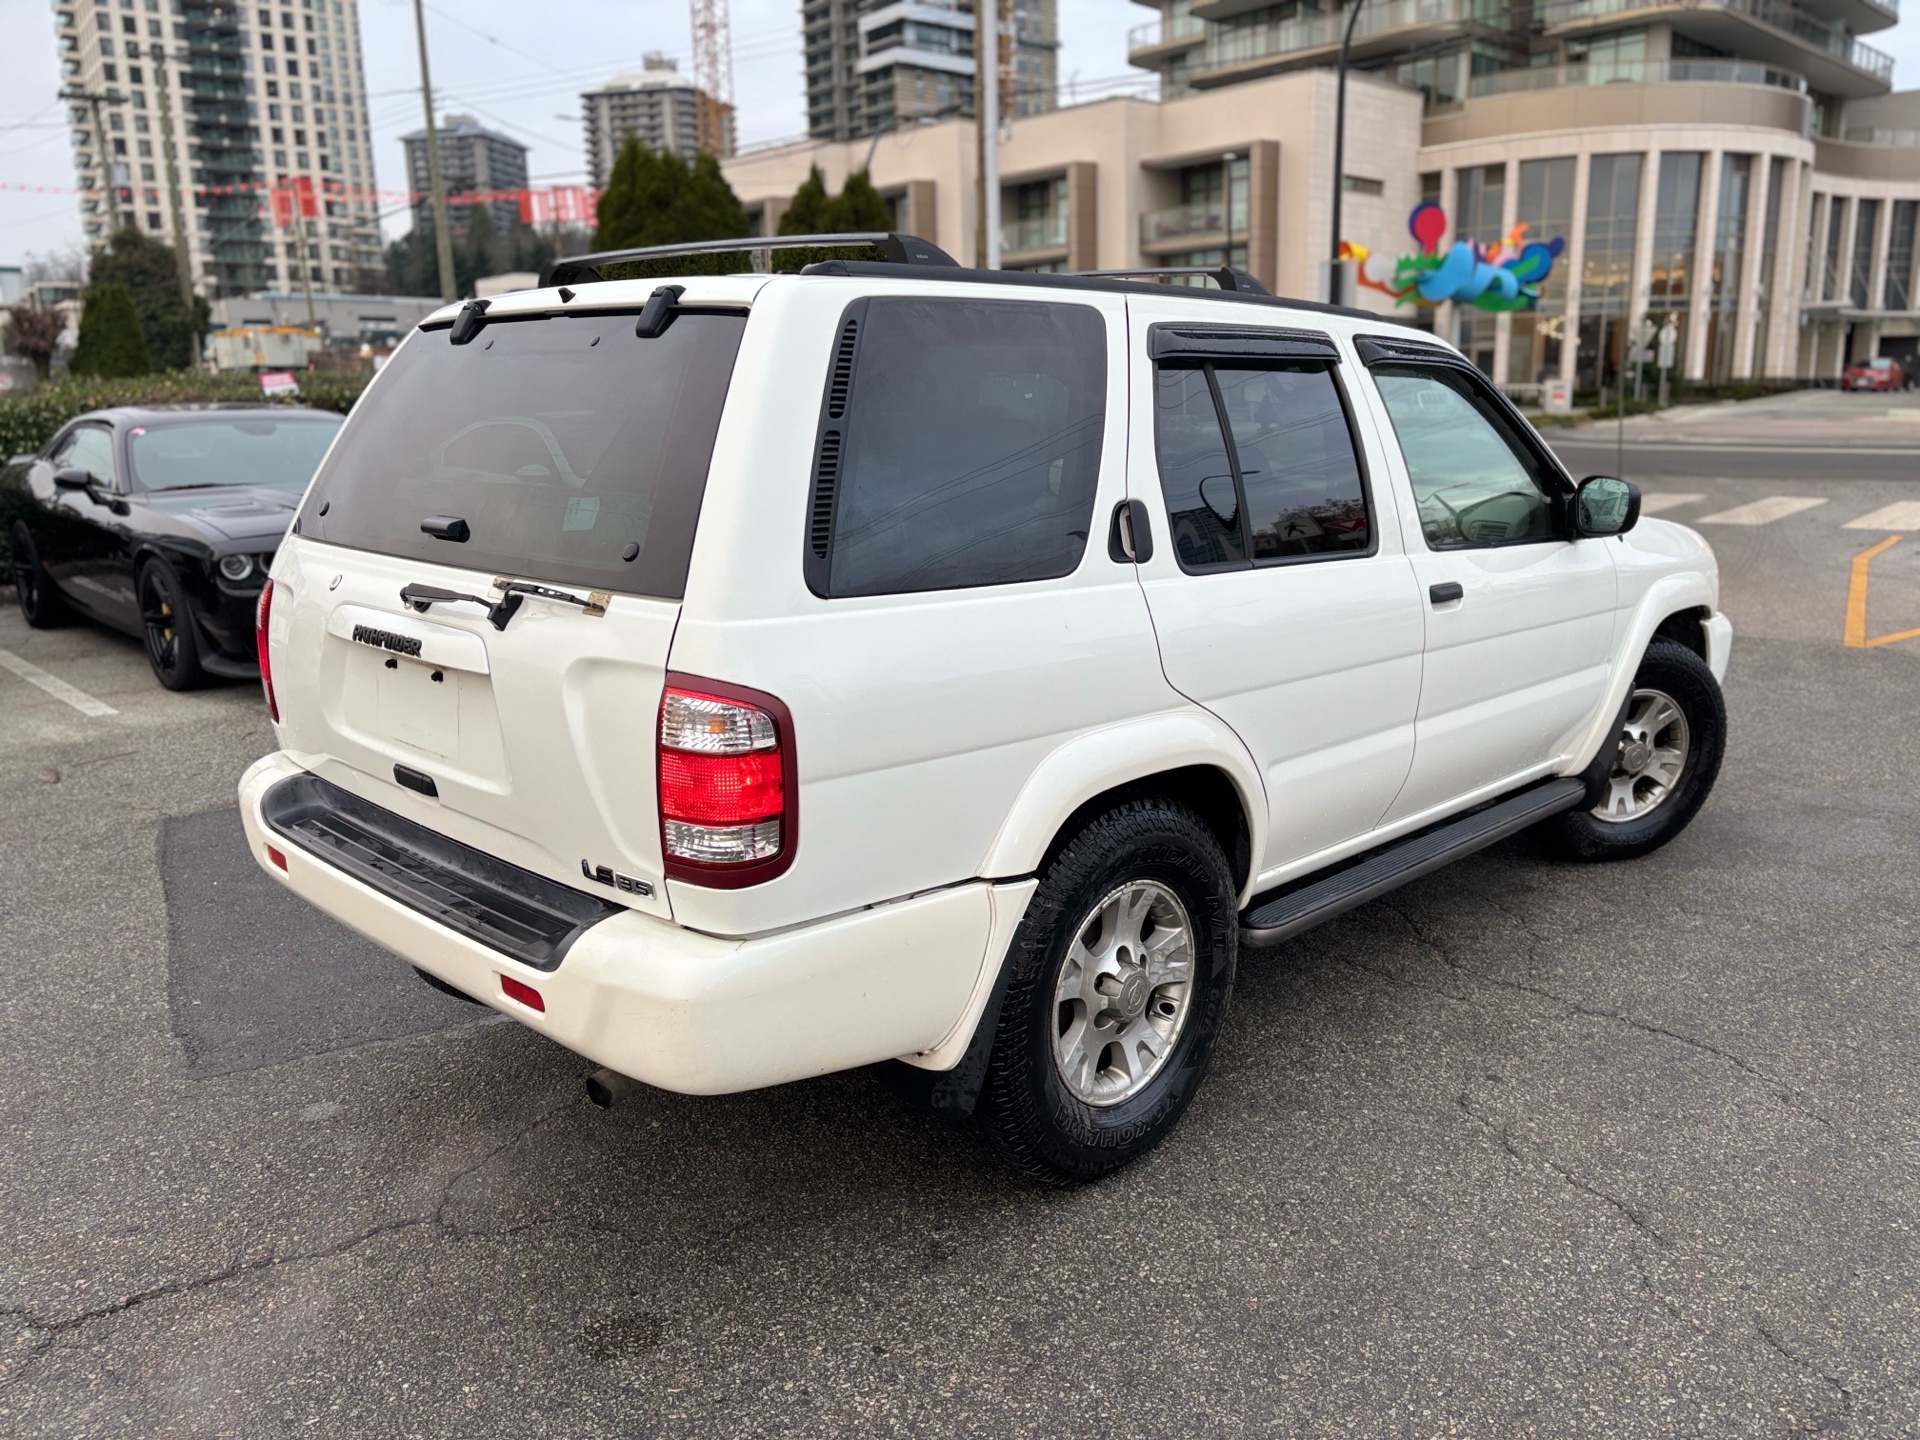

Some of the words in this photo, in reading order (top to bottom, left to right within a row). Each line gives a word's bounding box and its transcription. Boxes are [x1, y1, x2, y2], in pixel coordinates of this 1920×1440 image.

[352, 624, 422, 658] PATHFINDER
[581, 859, 616, 888] LE
[1054, 1091, 1180, 1147] YOKOHAMA
